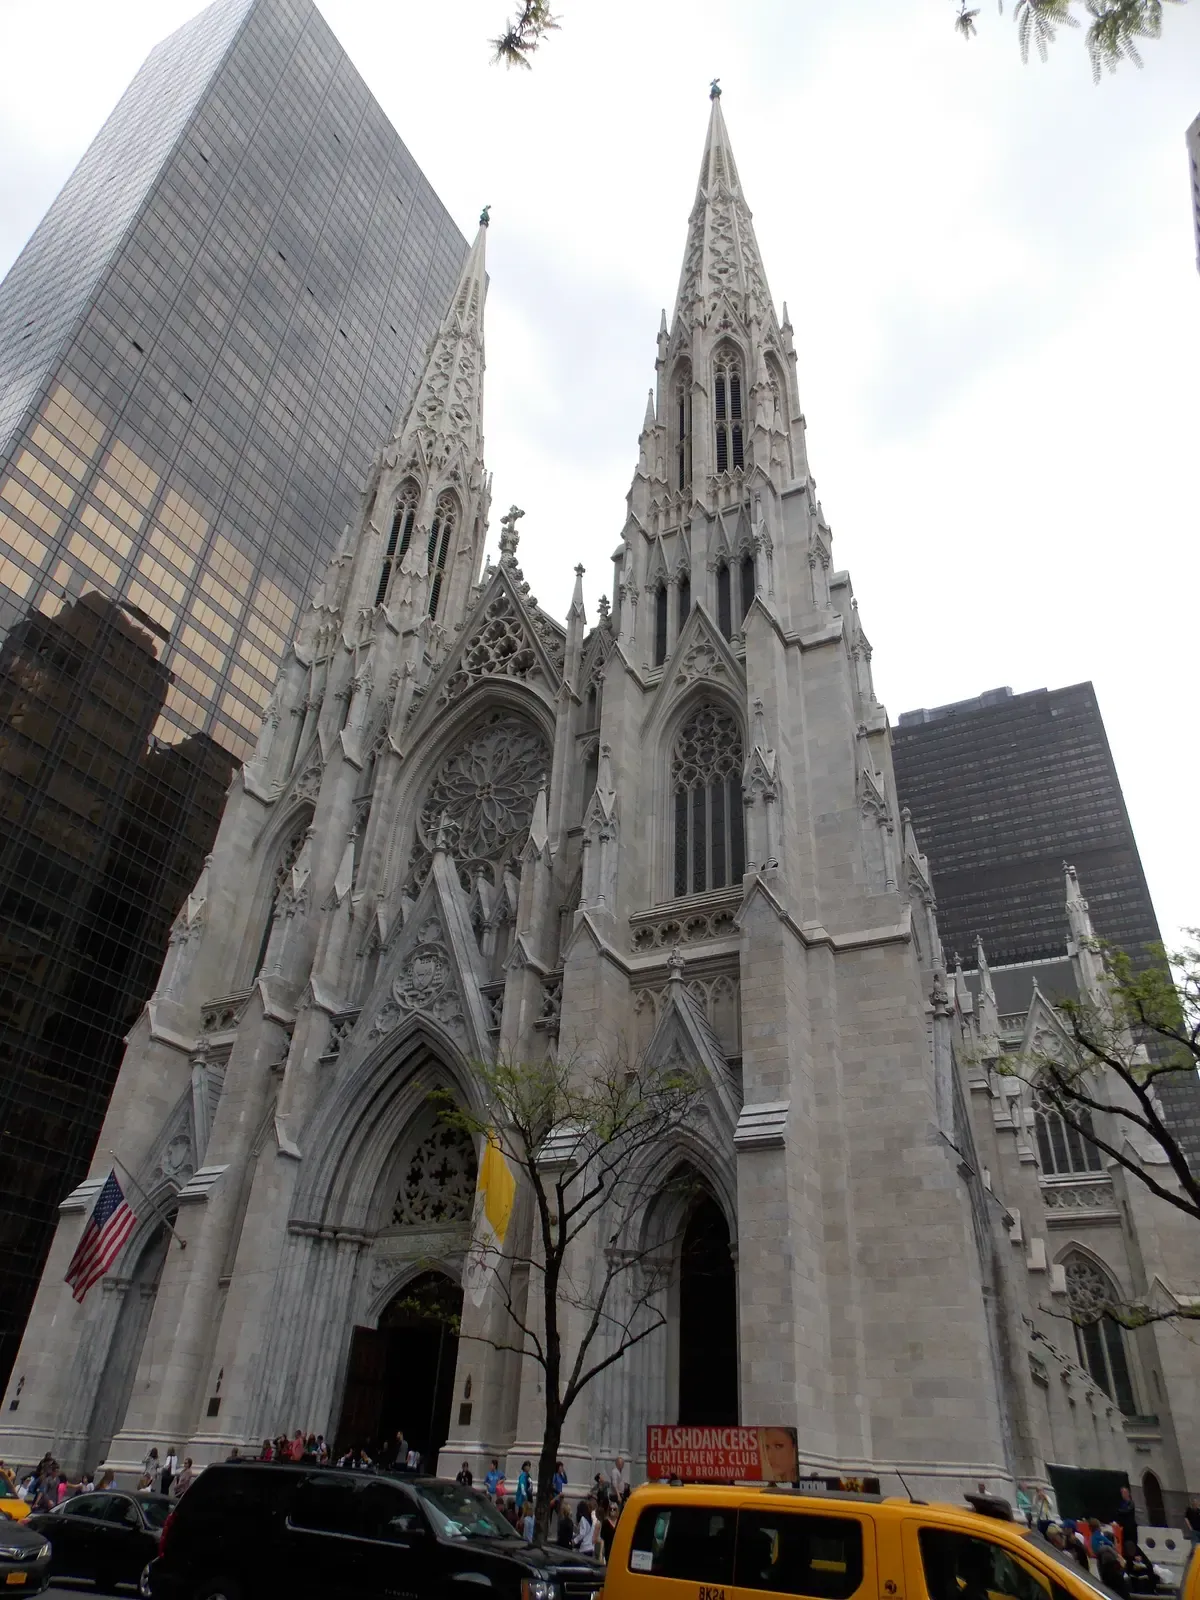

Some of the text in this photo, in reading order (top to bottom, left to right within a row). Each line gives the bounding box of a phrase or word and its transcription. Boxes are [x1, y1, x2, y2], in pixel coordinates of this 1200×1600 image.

[650, 1427, 758, 1450] FLASHDANCERS
[649, 1450, 758, 1466] GENTLEMEN'S CLUB
[695, 1466, 746, 1477] BROADWAY
